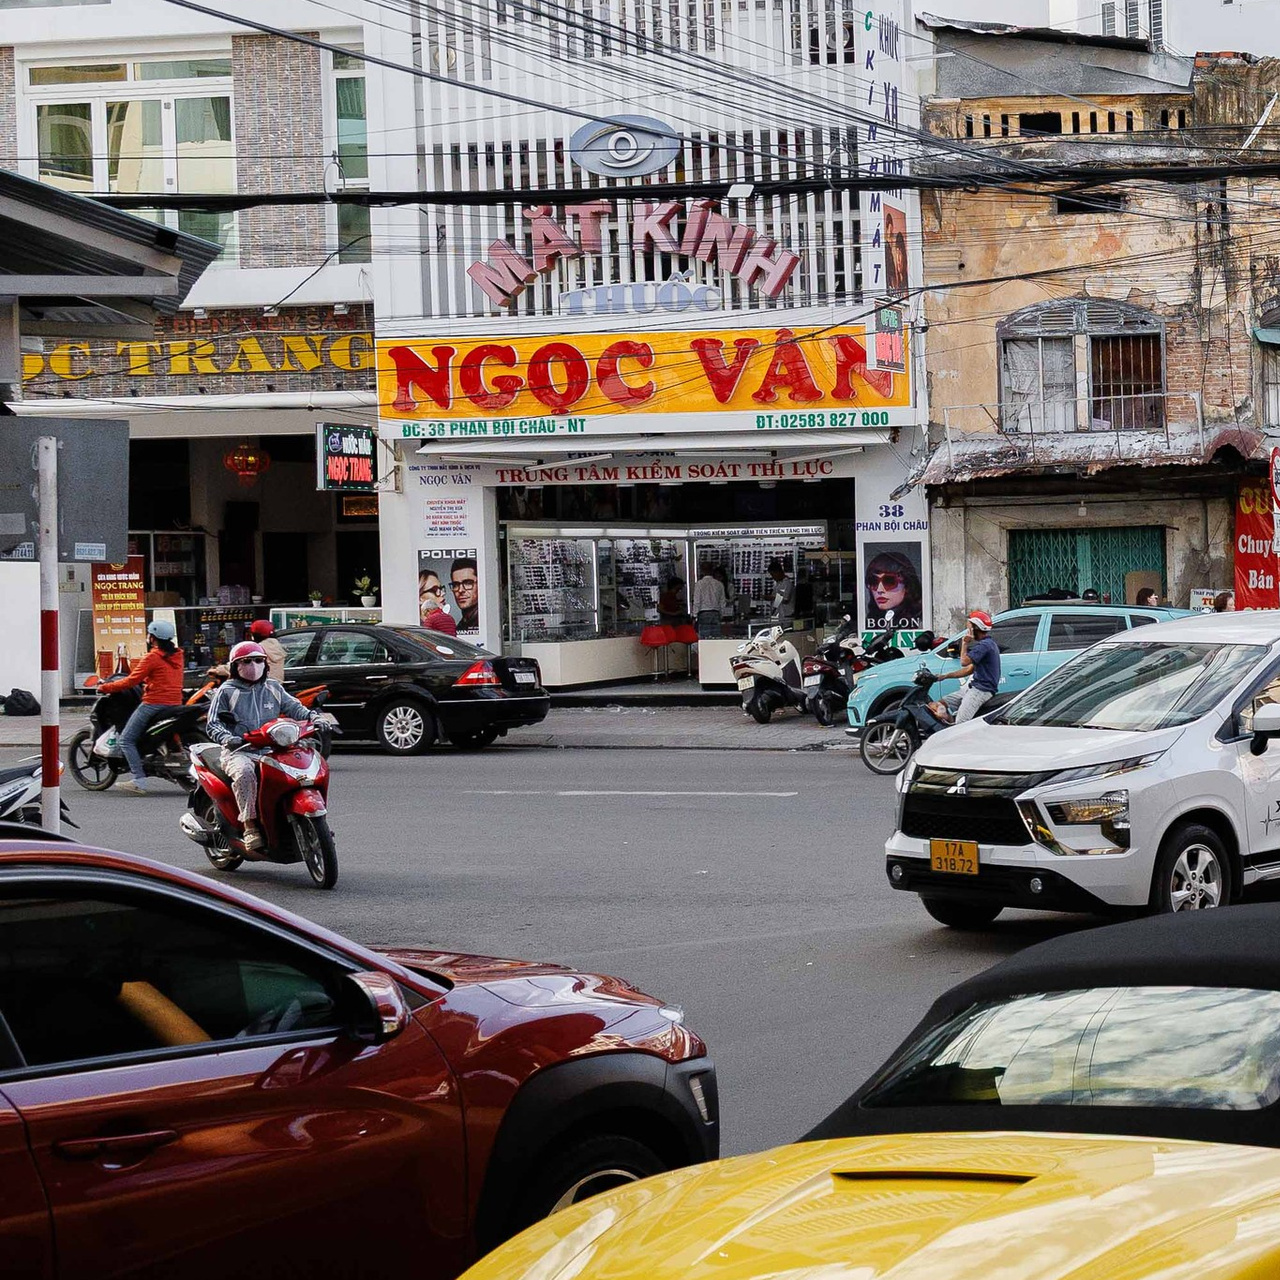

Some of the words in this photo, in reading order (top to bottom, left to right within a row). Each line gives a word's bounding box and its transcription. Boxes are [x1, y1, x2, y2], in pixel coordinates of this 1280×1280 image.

[560, 270, 721, 316] THUỐC
[116, 332, 376, 377] TRANG
[388, 340, 658, 415] NGỌC
[690, 327, 895, 404] VÂN
[830, 412, 857, 427] 827
[861, 411, 889, 426] 000
[402, 423, 425, 437] ĐC:
[428, 422, 445, 436] 38
[450, 421, 488, 435] PHAN
[493, 418, 515, 438] BỘI
[519, 416, 556, 434] CHÂU
[568, 418, 586, 433] NT
[328, 456, 349, 485] NGỌC
[496, 467, 569, 483] TRUNG
[574, 460, 620, 481] TÂM
[625, 458, 682, 480] KIỂM
[688, 459, 741, 480] SOÁT
[747, 460, 785, 479] THỊ
[791, 458, 833, 477] LỰC
[419, 475, 448, 487] NGỌC
[451, 472, 472, 485] VÂN
[879, 505, 904, 518] 38
[856, 522, 881, 532] PHAN
[884, 520, 901, 532] BỘI
[903, 518, 928, 531] CHÂU
[421, 549, 477, 559] POLICE
[94, 582, 117, 591] NGỌC
[118, 581, 144, 590] TRANG
[1248, 570, 1274, 590] Bán
[867, 617, 921, 628] BOLON
[945, 843, 964, 856] 17A
[935, 857, 973, 872] 318.72
